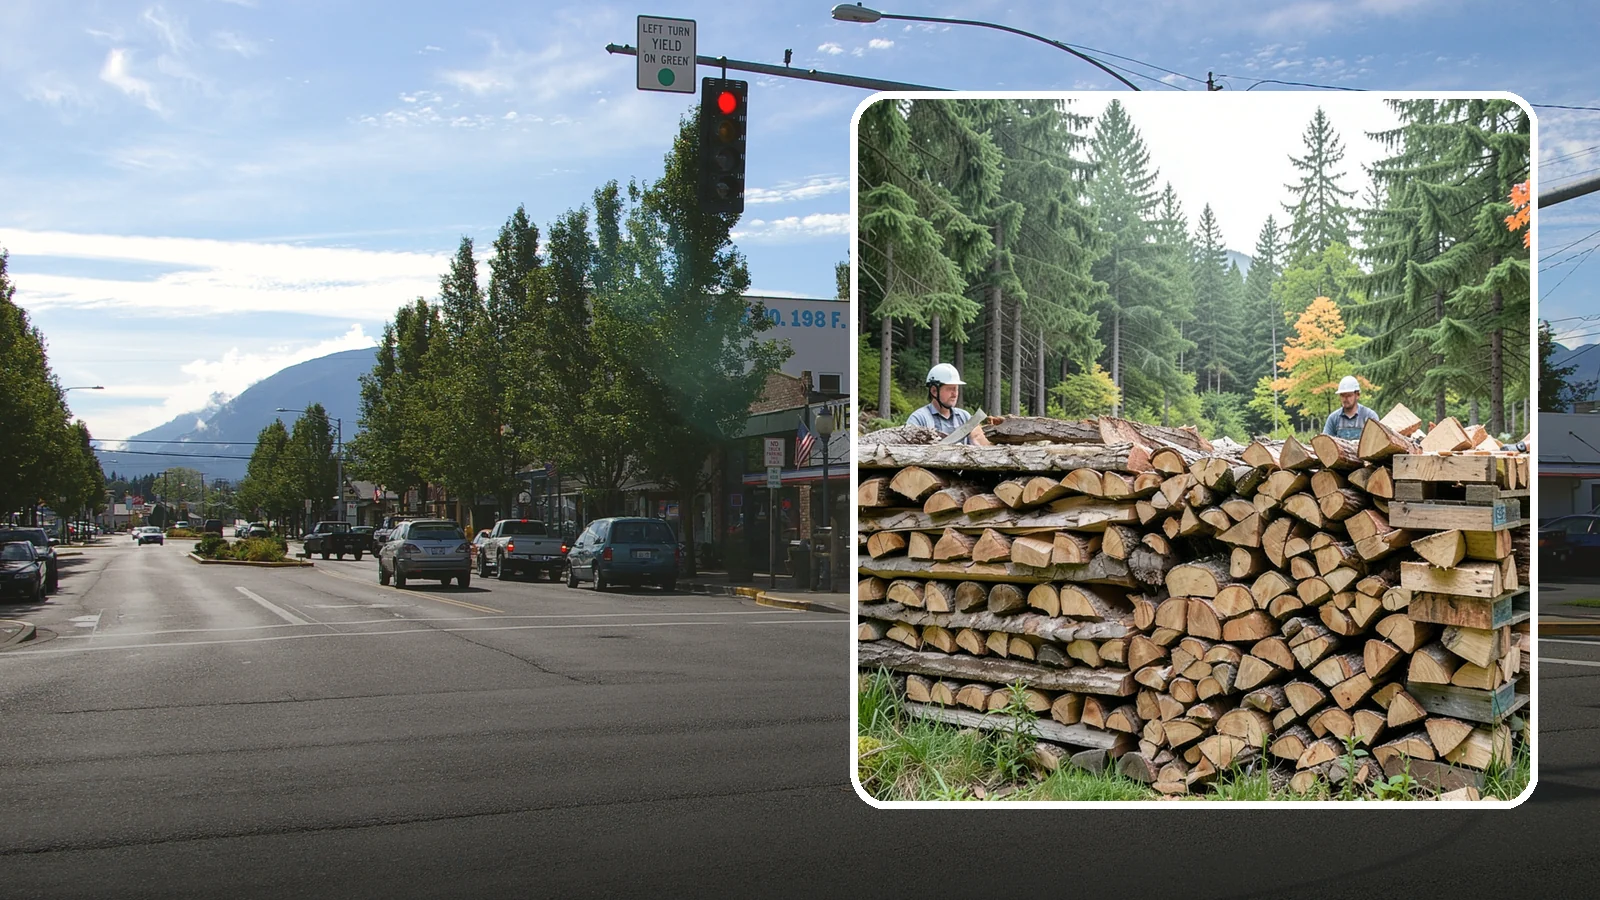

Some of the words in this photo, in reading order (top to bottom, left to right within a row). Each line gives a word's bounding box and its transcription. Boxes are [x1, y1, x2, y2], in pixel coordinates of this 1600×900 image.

[643, 24, 663, 34] LEFT
[668, 26, 690, 36] TURN
[652, 38, 682, 51] YIELD
[644, 53, 656, 63] ON
[661, 55, 689, 66] GREEN
[791, 309, 826, 328] 198
[831, 311, 847, 329] F.
